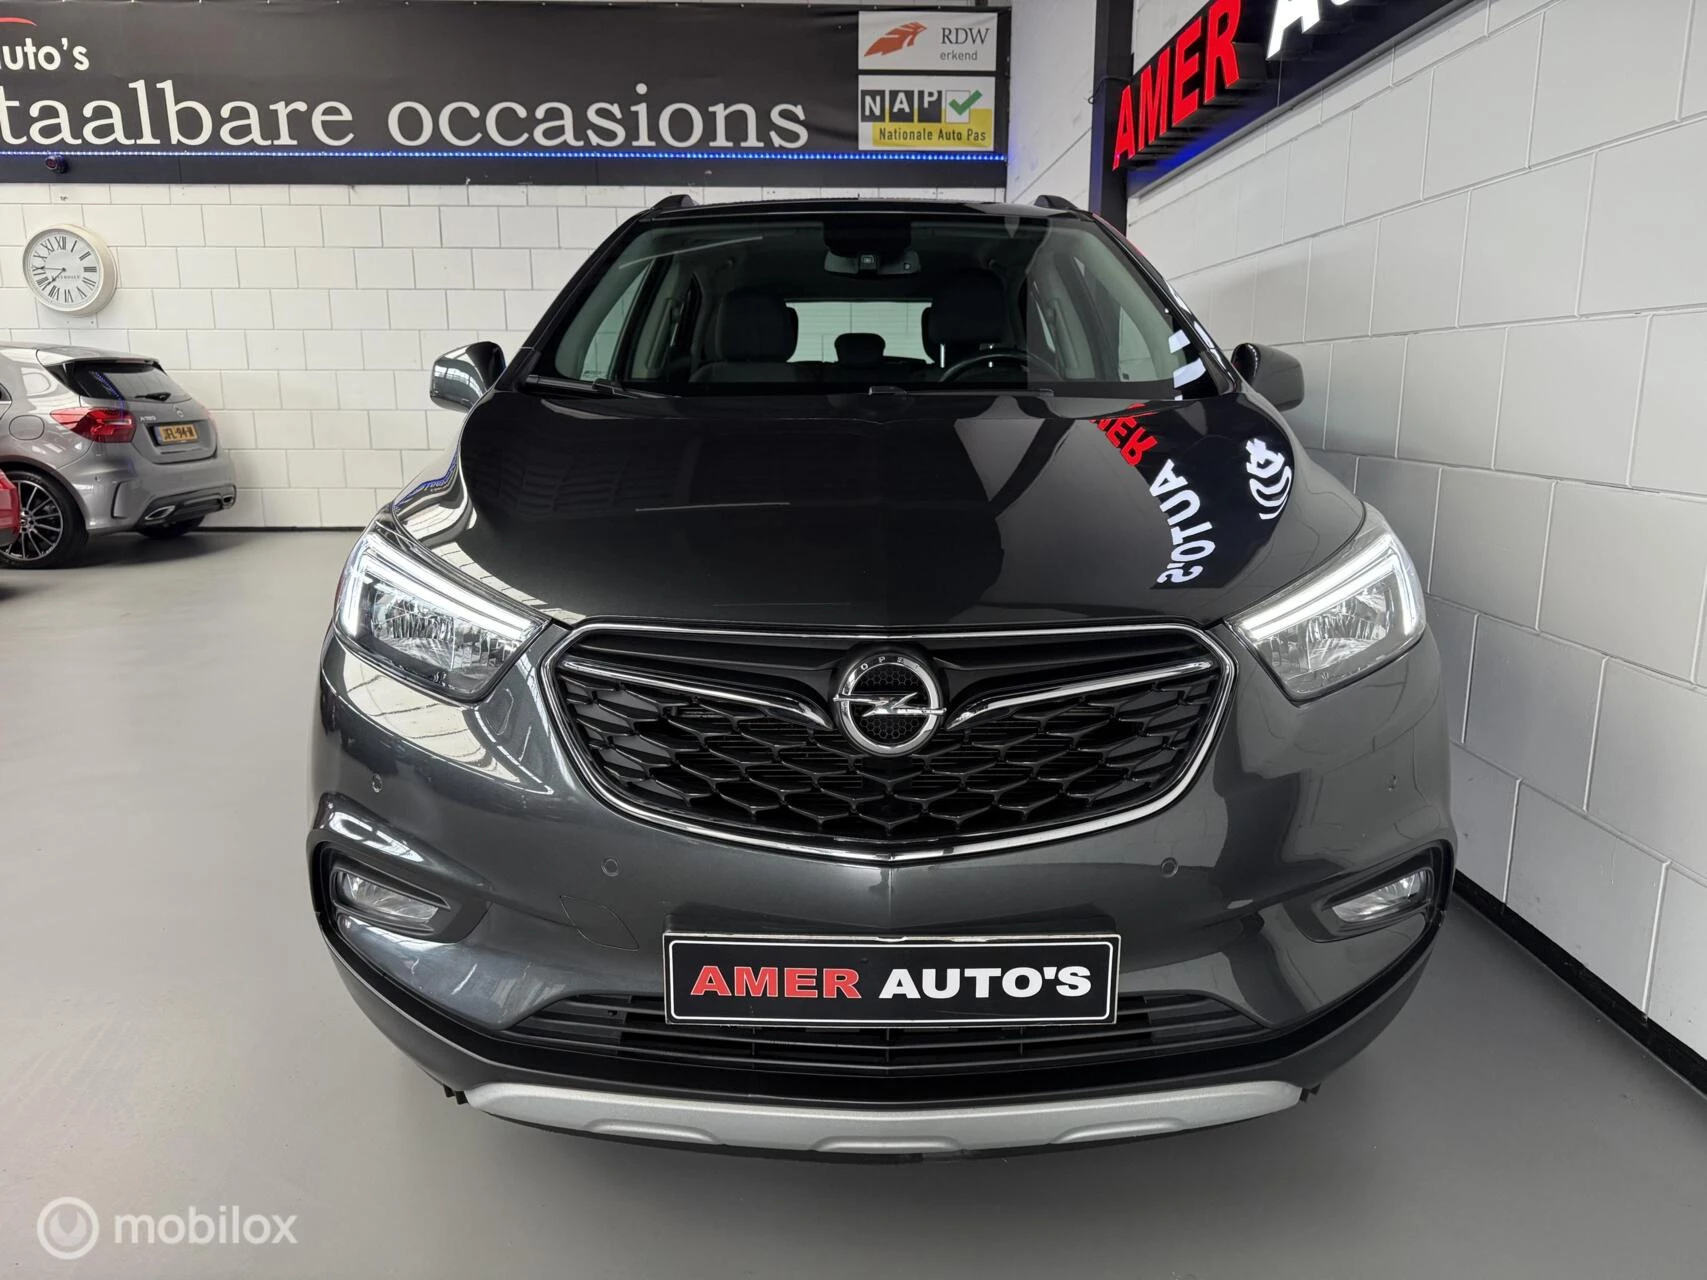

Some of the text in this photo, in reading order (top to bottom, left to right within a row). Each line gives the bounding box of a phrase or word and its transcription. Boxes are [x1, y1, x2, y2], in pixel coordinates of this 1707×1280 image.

[941, 27, 990, 45] RDW
[0, 38, 90, 71] uto's
[940, 50, 978, 61] erkend
[1113, 0, 1241, 170] AMER
[388, 83, 809, 148] occasions
[864, 90, 938, 117] NAP
[879, 128, 986, 141] Nationale Auto Pas
[690, 965, 1092, 999] AMER AUTO'S
